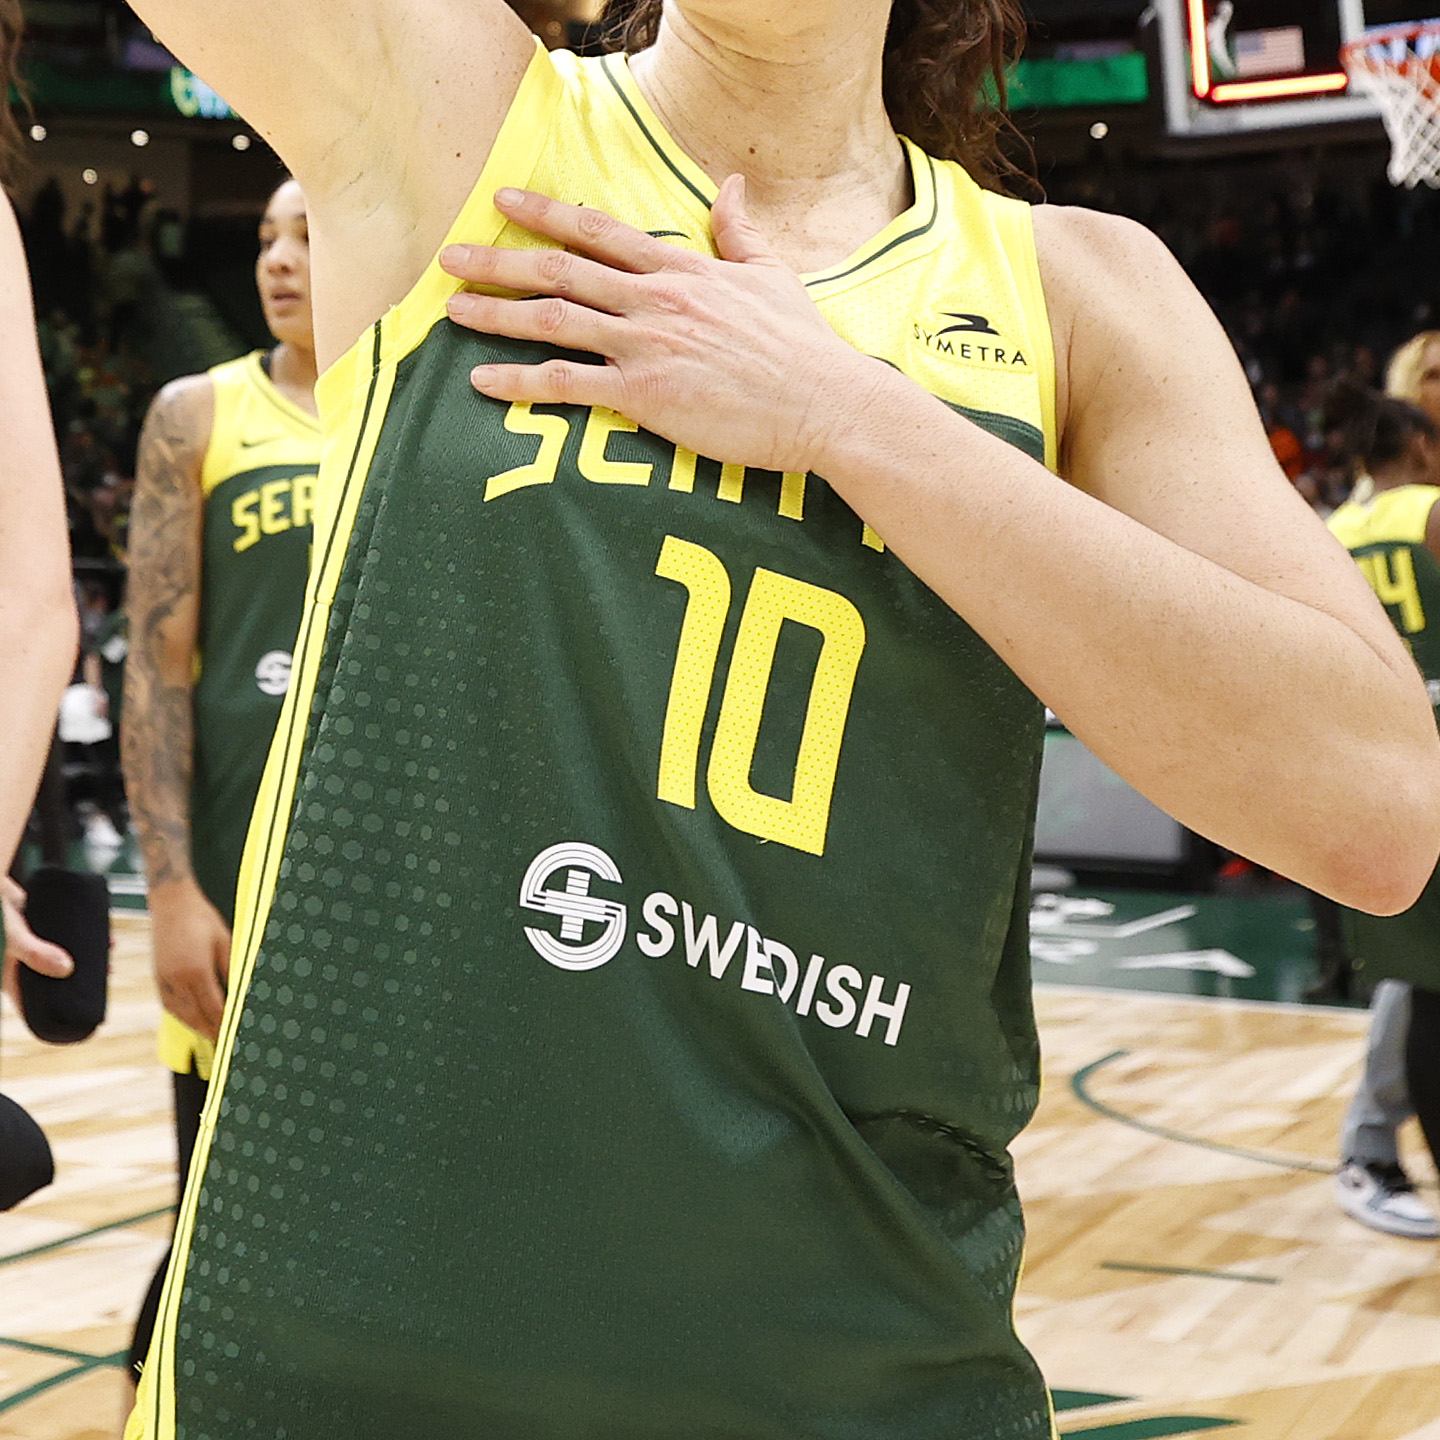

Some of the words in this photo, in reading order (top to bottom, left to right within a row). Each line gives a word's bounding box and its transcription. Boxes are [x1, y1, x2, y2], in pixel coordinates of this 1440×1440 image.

[912, 323, 1029, 367] SYMETRA
[655, 533, 866, 857] 10
[636, 890, 912, 1047] SWEDISH
